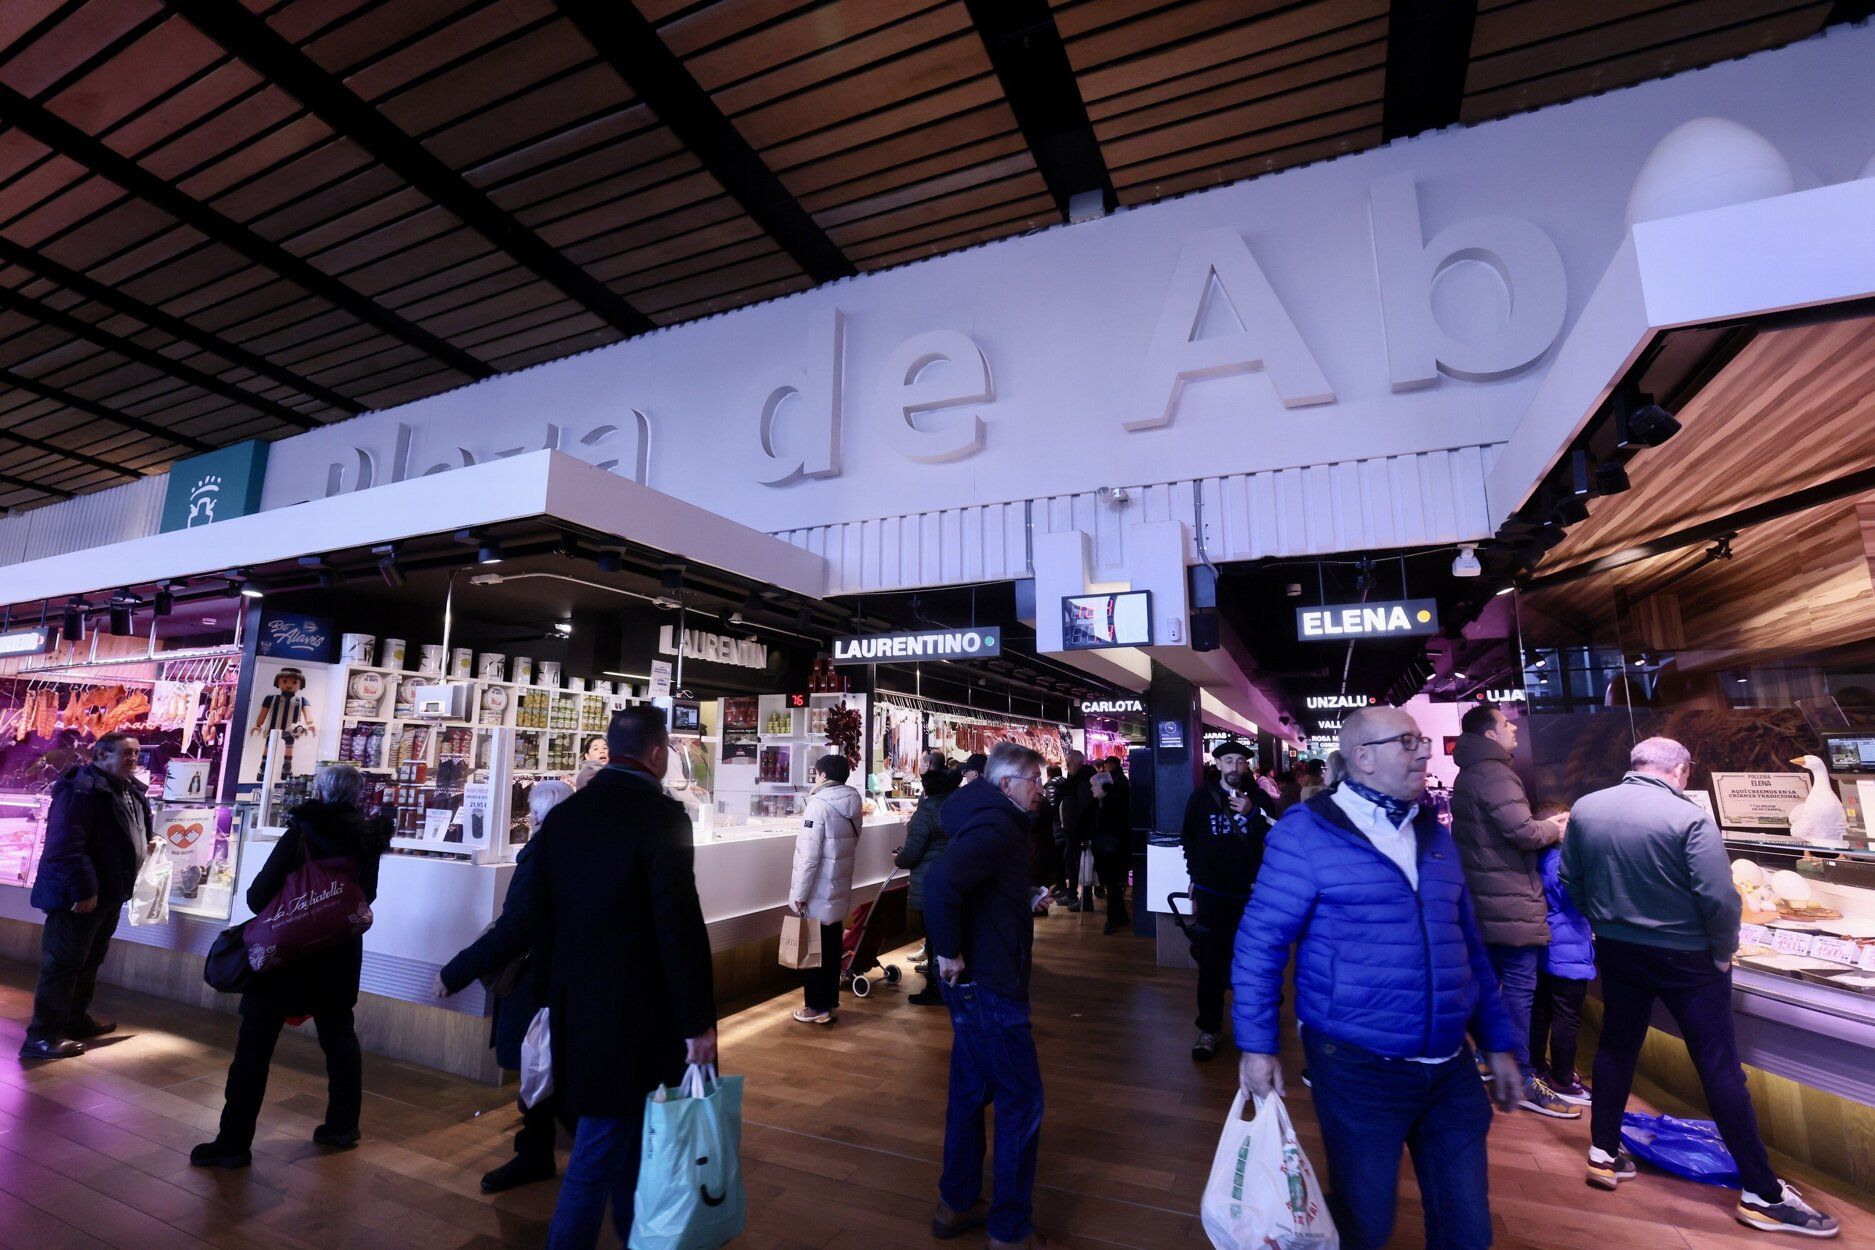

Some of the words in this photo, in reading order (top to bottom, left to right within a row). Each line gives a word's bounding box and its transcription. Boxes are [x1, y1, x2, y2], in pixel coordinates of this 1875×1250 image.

[733, 306, 996, 490] de
[1122, 169, 1568, 433] Ab
[1303, 606, 1412, 636] ELENA
[835, 632, 981, 659] LAURENTINO
[1081, 700, 1142, 712] CARLOTA
[1307, 695, 1367, 708] UNZALU
[1318, 721, 1345, 729] VALL
